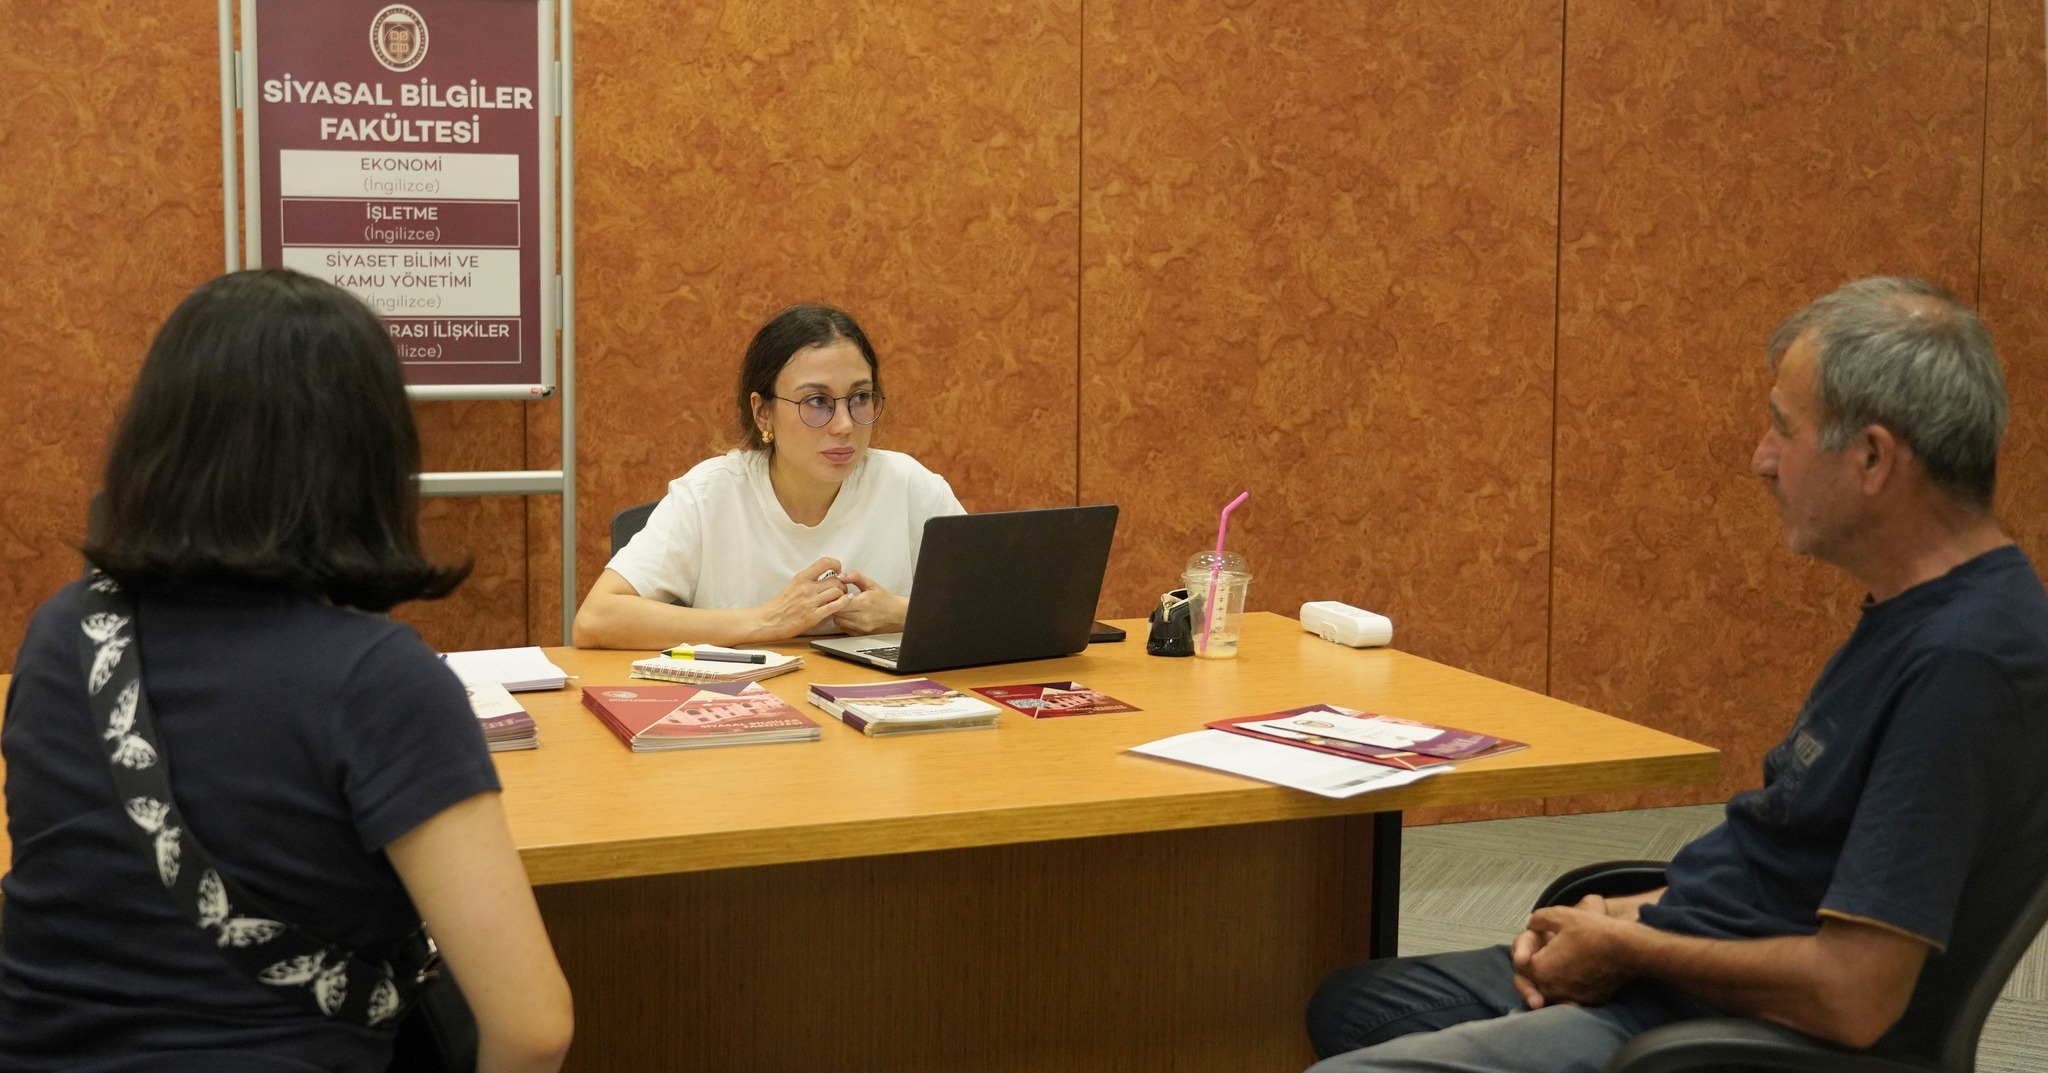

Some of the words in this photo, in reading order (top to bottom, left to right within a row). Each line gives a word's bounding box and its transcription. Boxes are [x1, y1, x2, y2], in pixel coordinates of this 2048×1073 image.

[263, 73, 392, 106] SİYASAL
[401, 77, 534, 109] BİLGİLER
[320, 112, 480, 143] FAKÜLTESİ
[360, 156, 443, 172] EKONOMİ
[363, 176, 441, 196] (İngilizce)
[365, 202, 438, 223] İŞLETME
[364, 224, 441, 243] (İngilizce)
[326, 250, 398, 268] SİYASET
[404, 251, 451, 268] BİLİMİ
[457, 255, 480, 268] VE
[334, 274, 385, 288] KAMU
[390, 271, 472, 288] YÖNETİMİ
[433, 321, 510, 341] İLİŞKİLER
